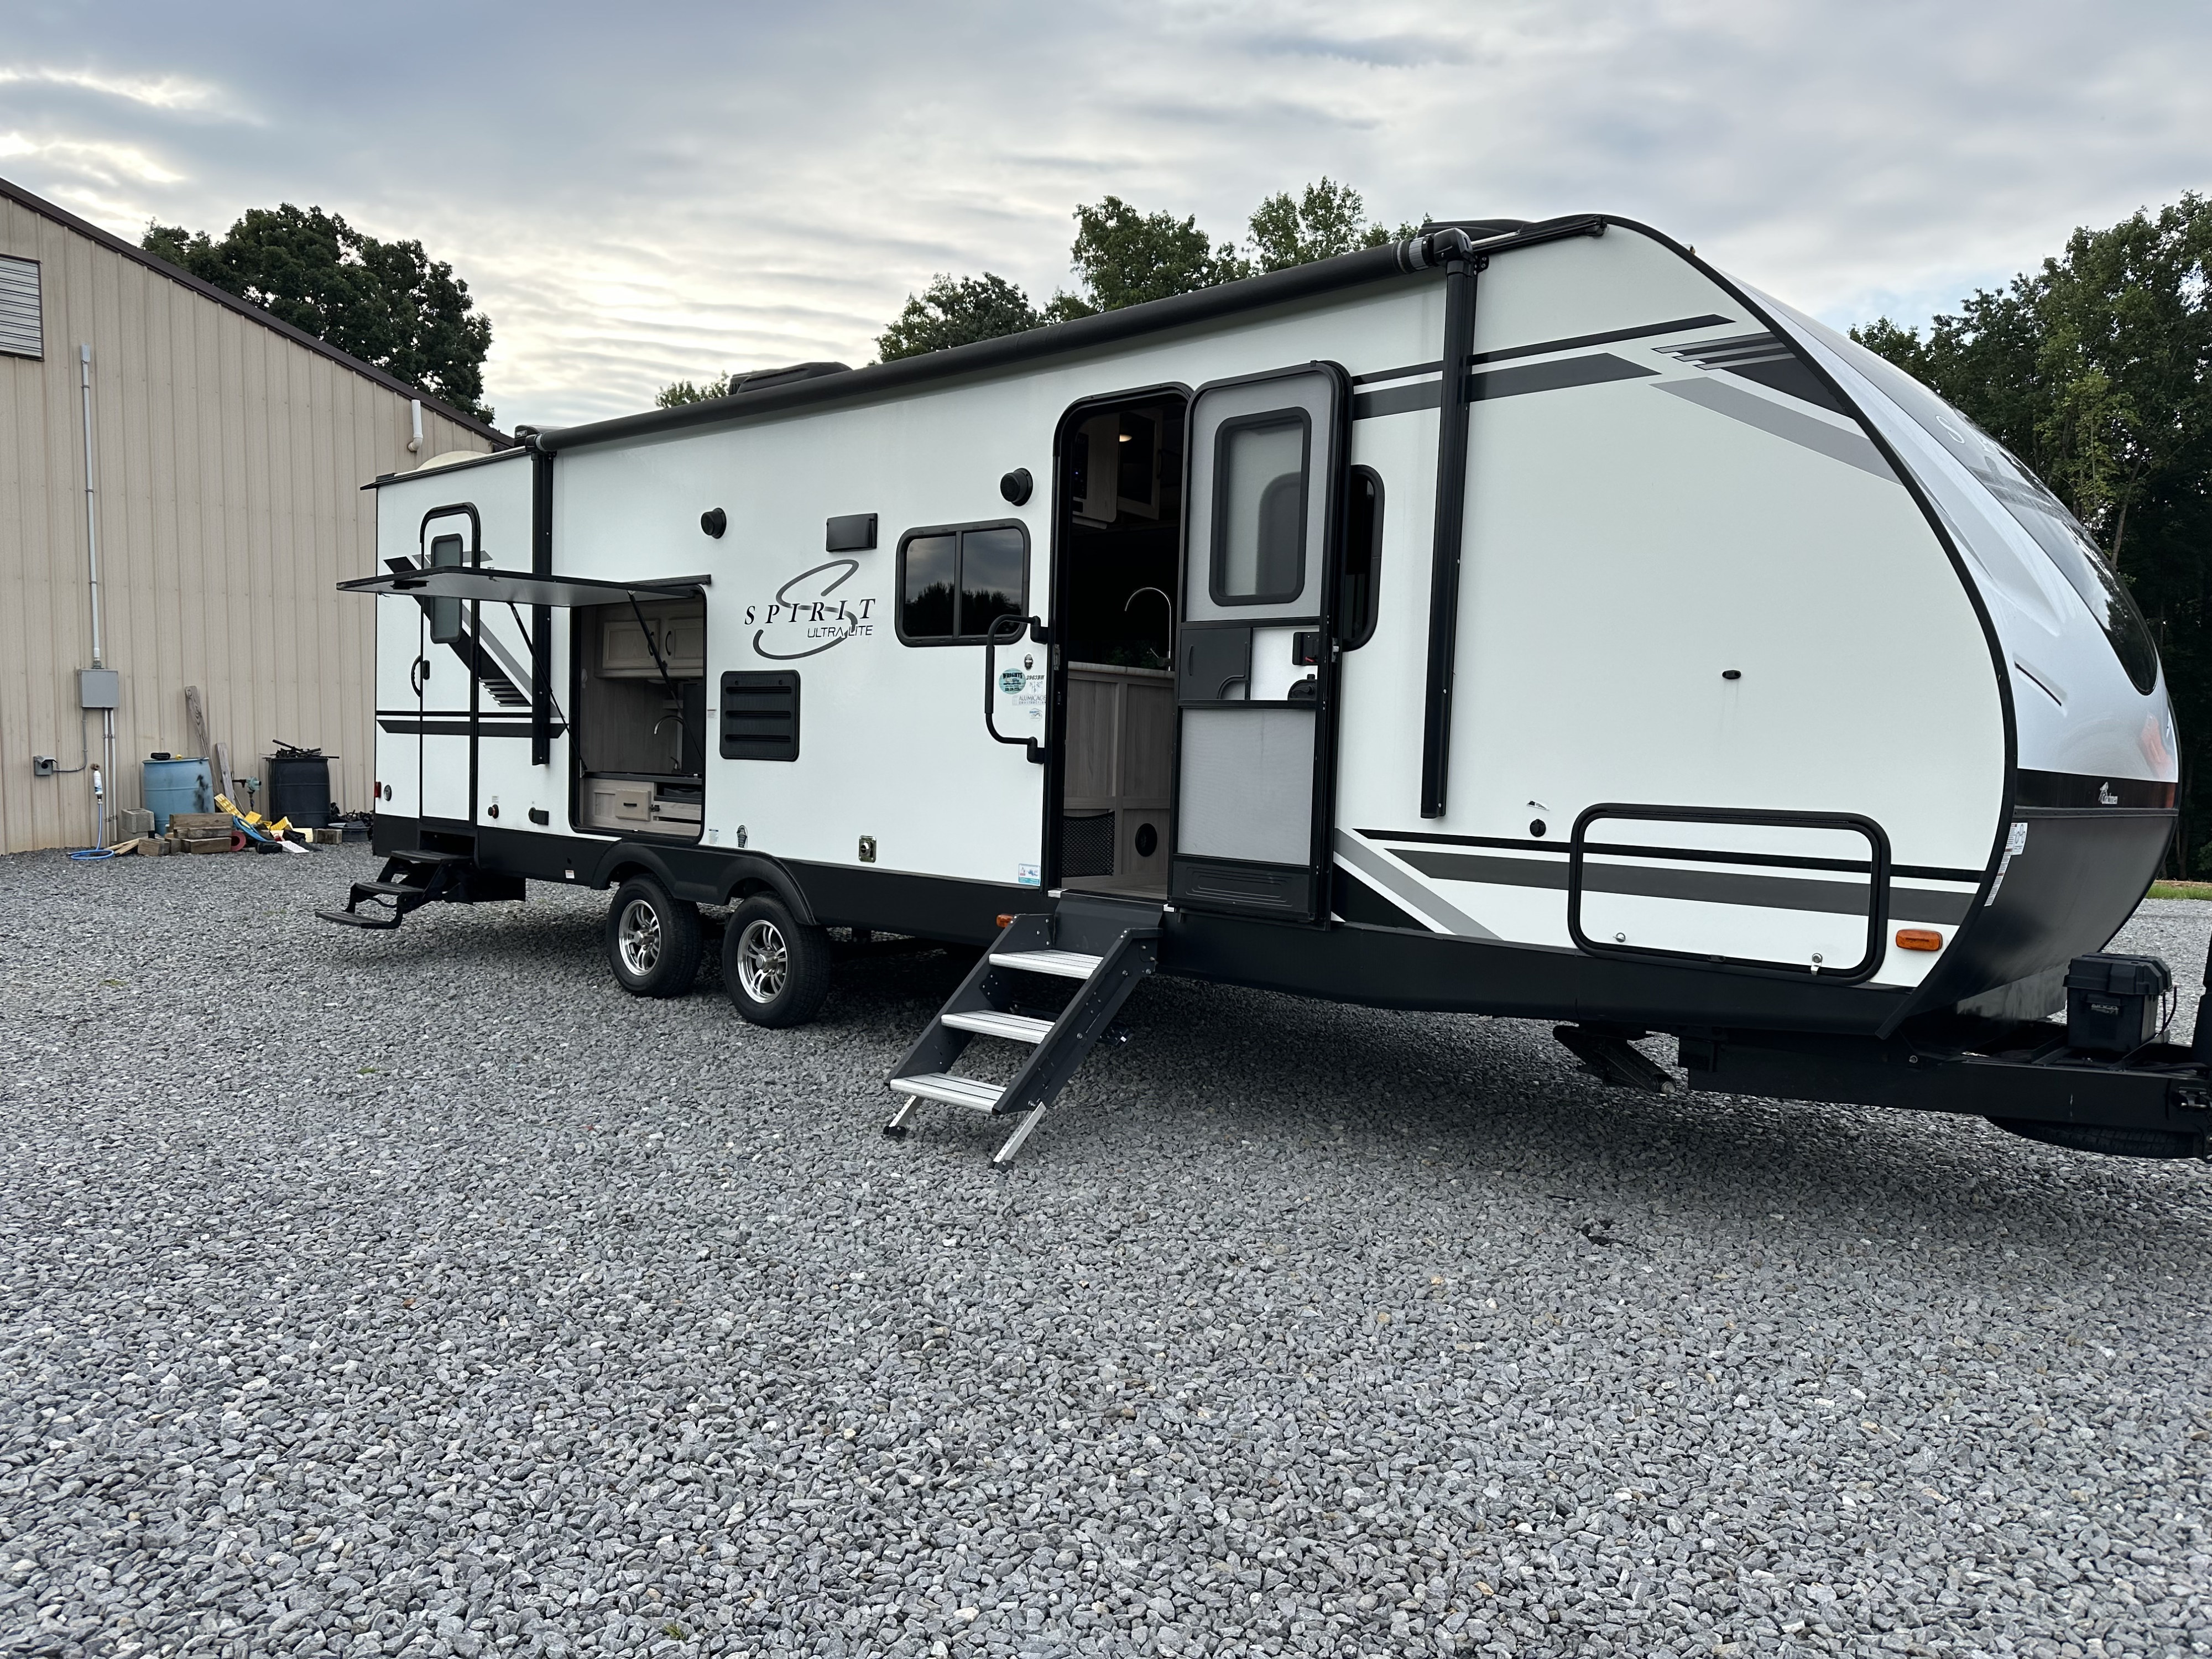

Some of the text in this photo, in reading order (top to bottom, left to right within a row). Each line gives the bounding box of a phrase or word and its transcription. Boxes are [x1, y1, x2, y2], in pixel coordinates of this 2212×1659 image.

[744, 598, 876, 625] SPIRIT
[807, 625, 873, 638] ULTRA LITE
